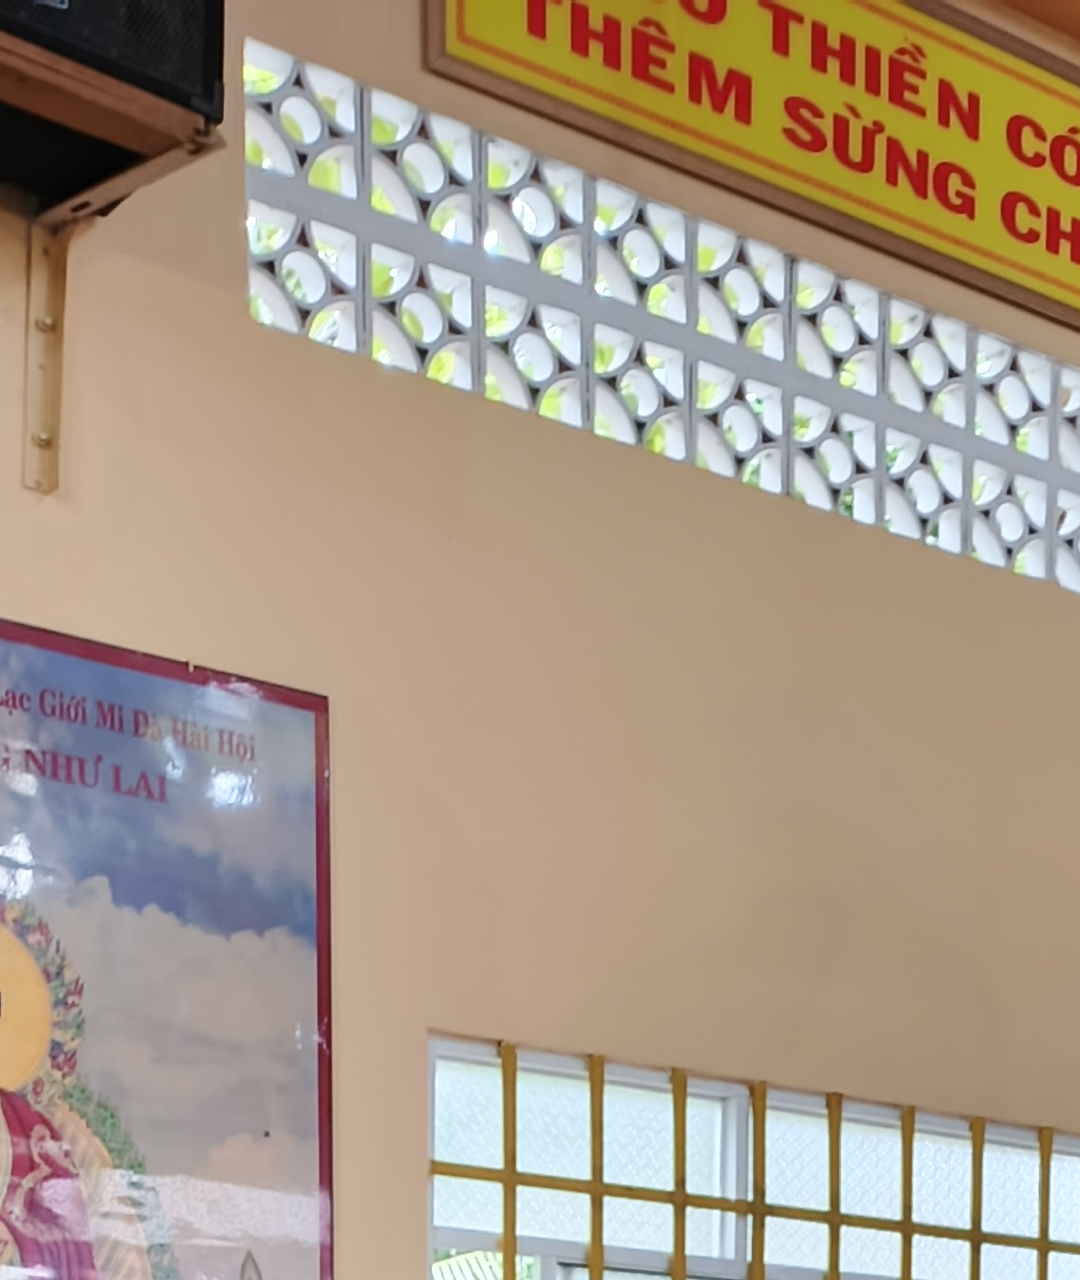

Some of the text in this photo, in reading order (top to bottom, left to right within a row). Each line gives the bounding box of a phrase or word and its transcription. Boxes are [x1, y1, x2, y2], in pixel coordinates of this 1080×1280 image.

[526, 0, 753, 126] THÊM
[782, 96, 976, 221] SỪNG
[757, 0, 981, 142] THIỀN
[0, 687, 31, 716] ạc
[38, 688, 87, 727] Giới
[95, 698, 125, 733] Mi
[25, 748, 104, 789] NHƯ
[112, 764, 169, 804] LAI
